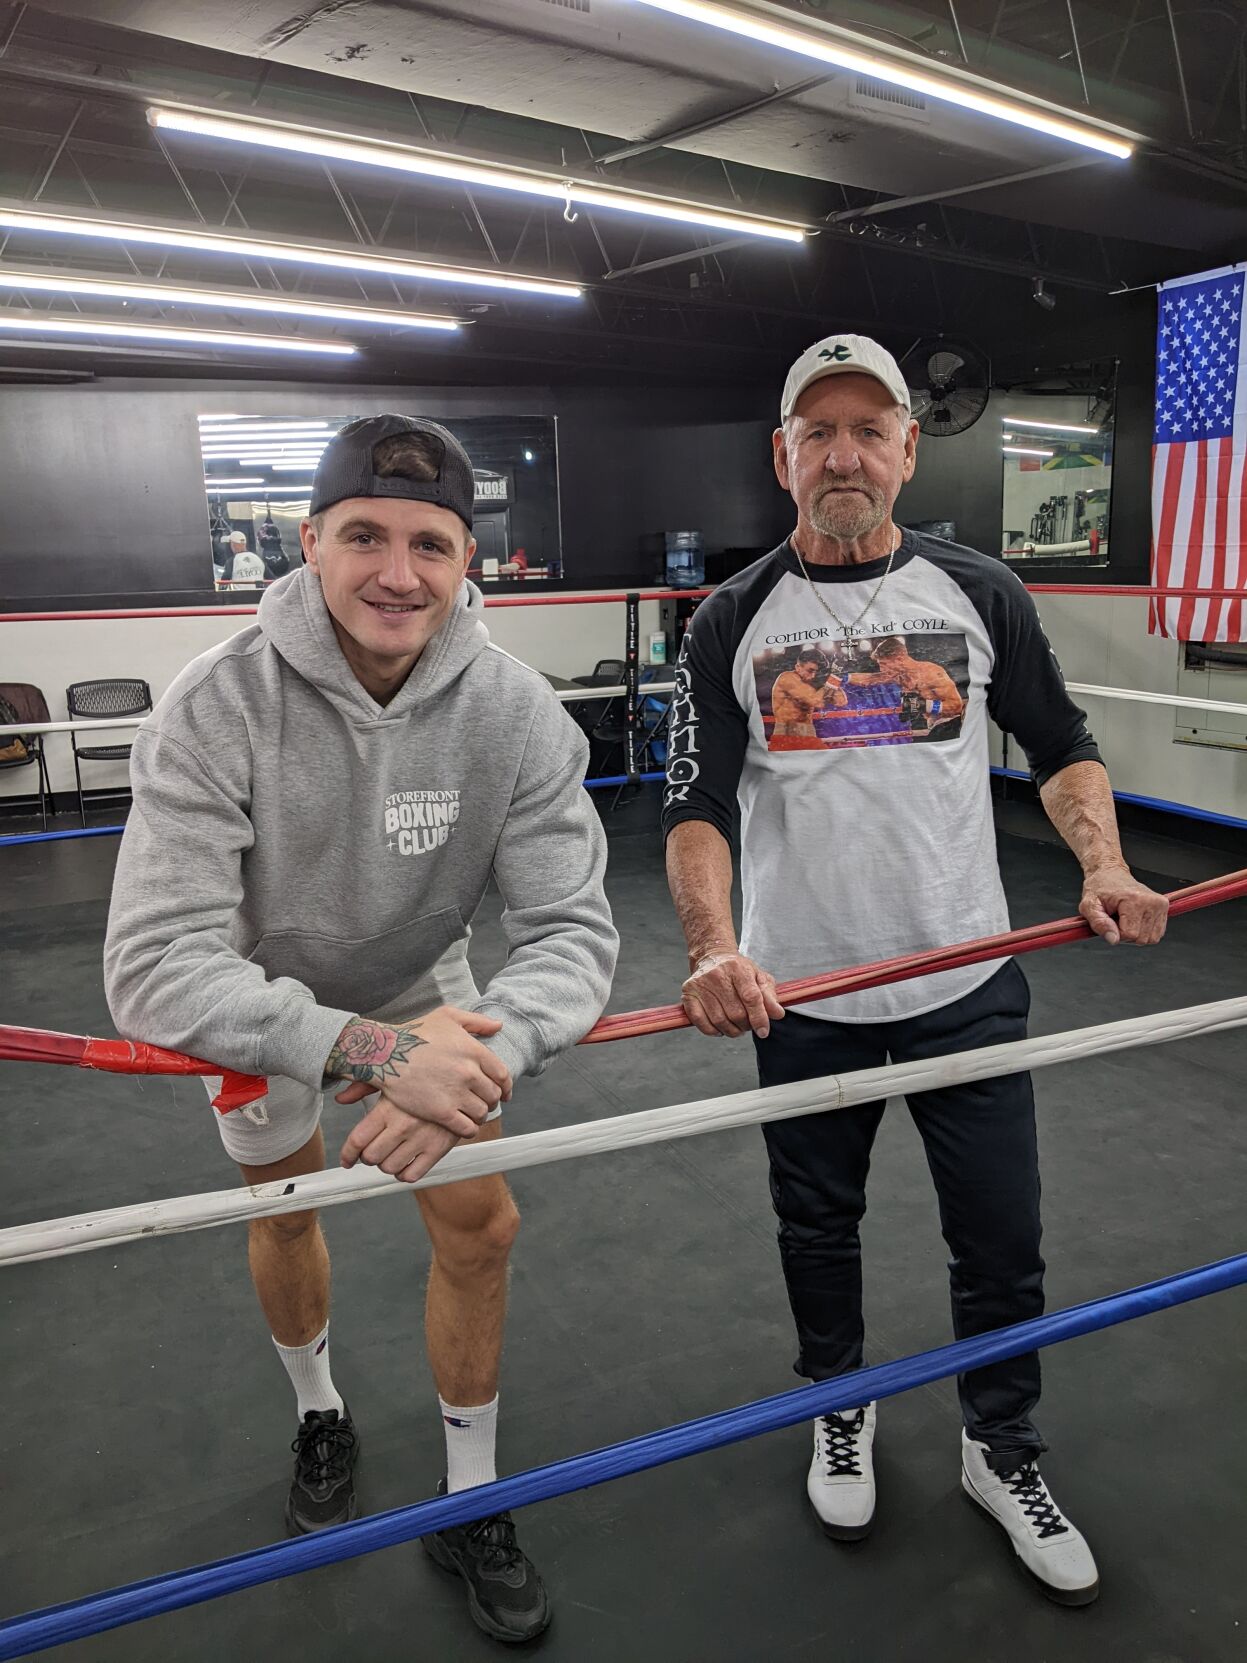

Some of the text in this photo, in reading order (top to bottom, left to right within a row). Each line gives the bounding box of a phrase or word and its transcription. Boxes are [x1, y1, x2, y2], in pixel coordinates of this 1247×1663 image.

[765, 627, 830, 645] CONNOR
[902, 618, 949, 631] COYLE
[628, 730, 636, 773] TITLE
[384, 790, 461, 809] STOREFRONT
[384, 801, 460, 834] BOXING
[398, 825, 450, 856] CLUB
